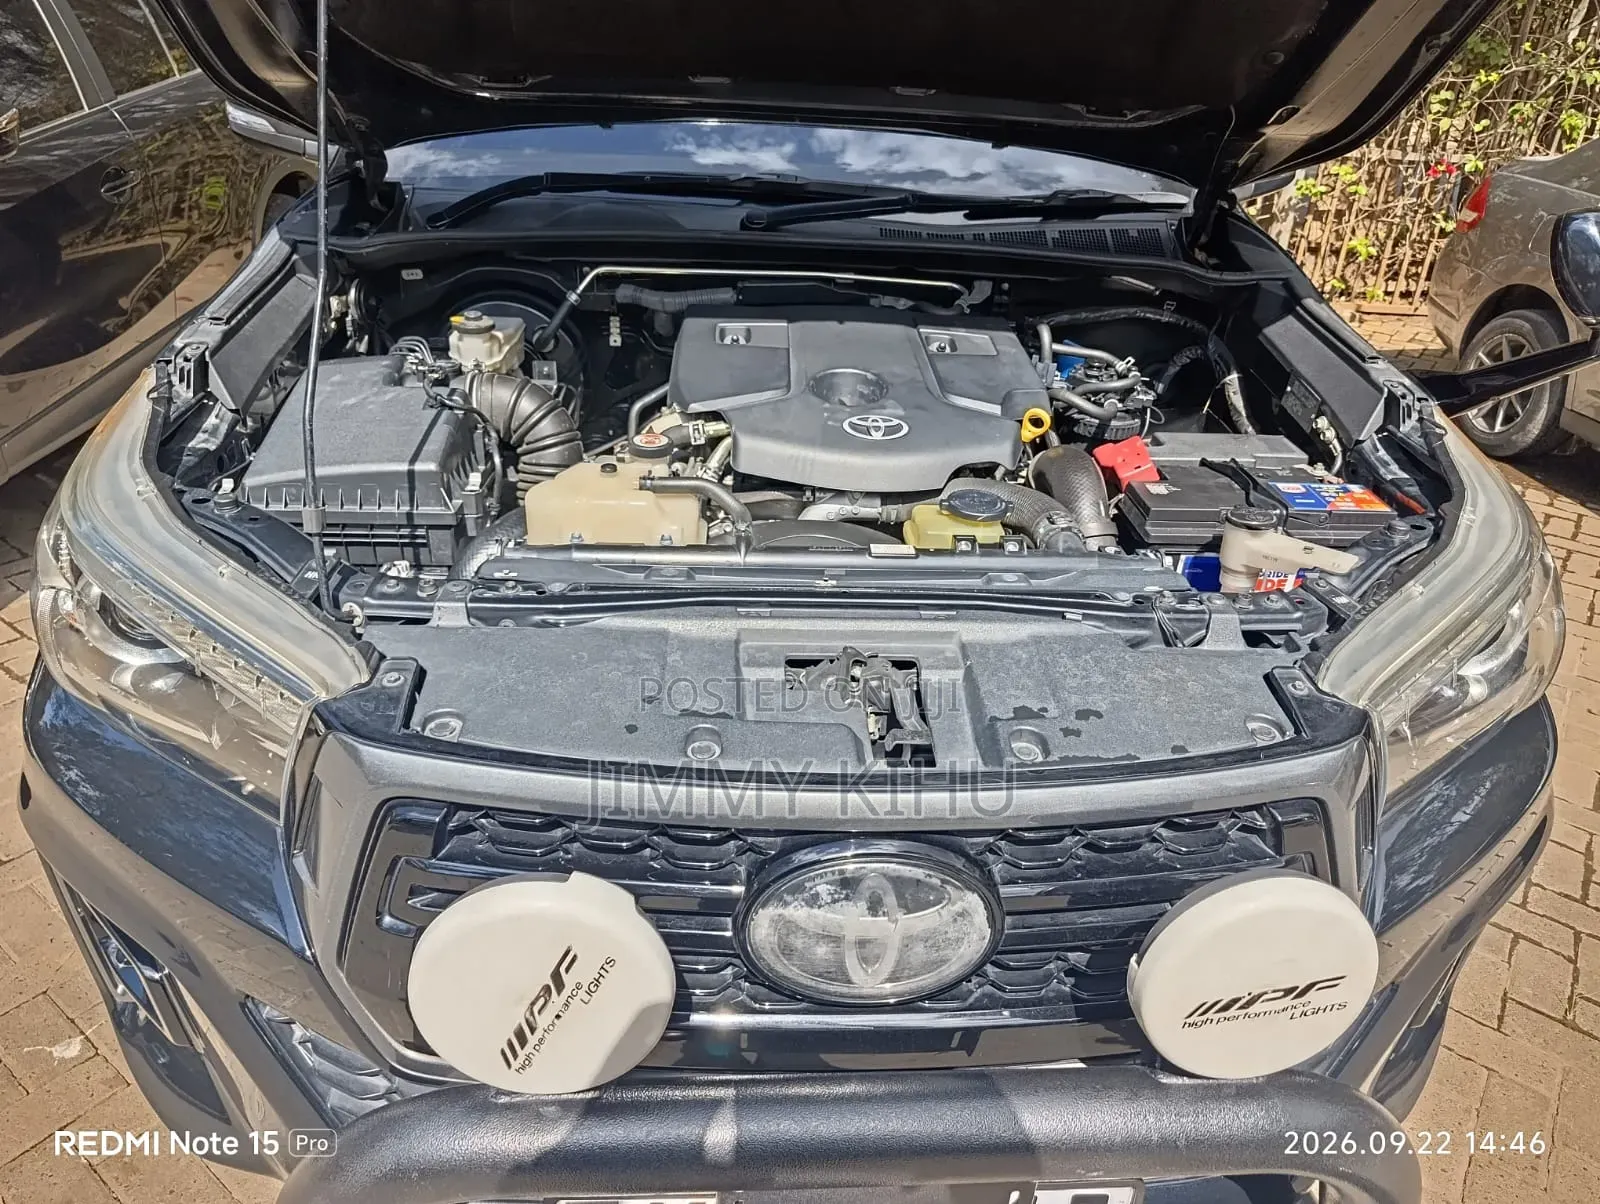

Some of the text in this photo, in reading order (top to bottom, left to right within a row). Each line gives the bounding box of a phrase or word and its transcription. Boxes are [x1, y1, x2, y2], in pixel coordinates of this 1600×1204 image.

[581, 956, 616, 1006] LIGHTS
[1181, 1000, 1312, 1029] high performance
[1289, 1001, 1348, 1021] LIGHTS
[515, 1050, 534, 1075] high
